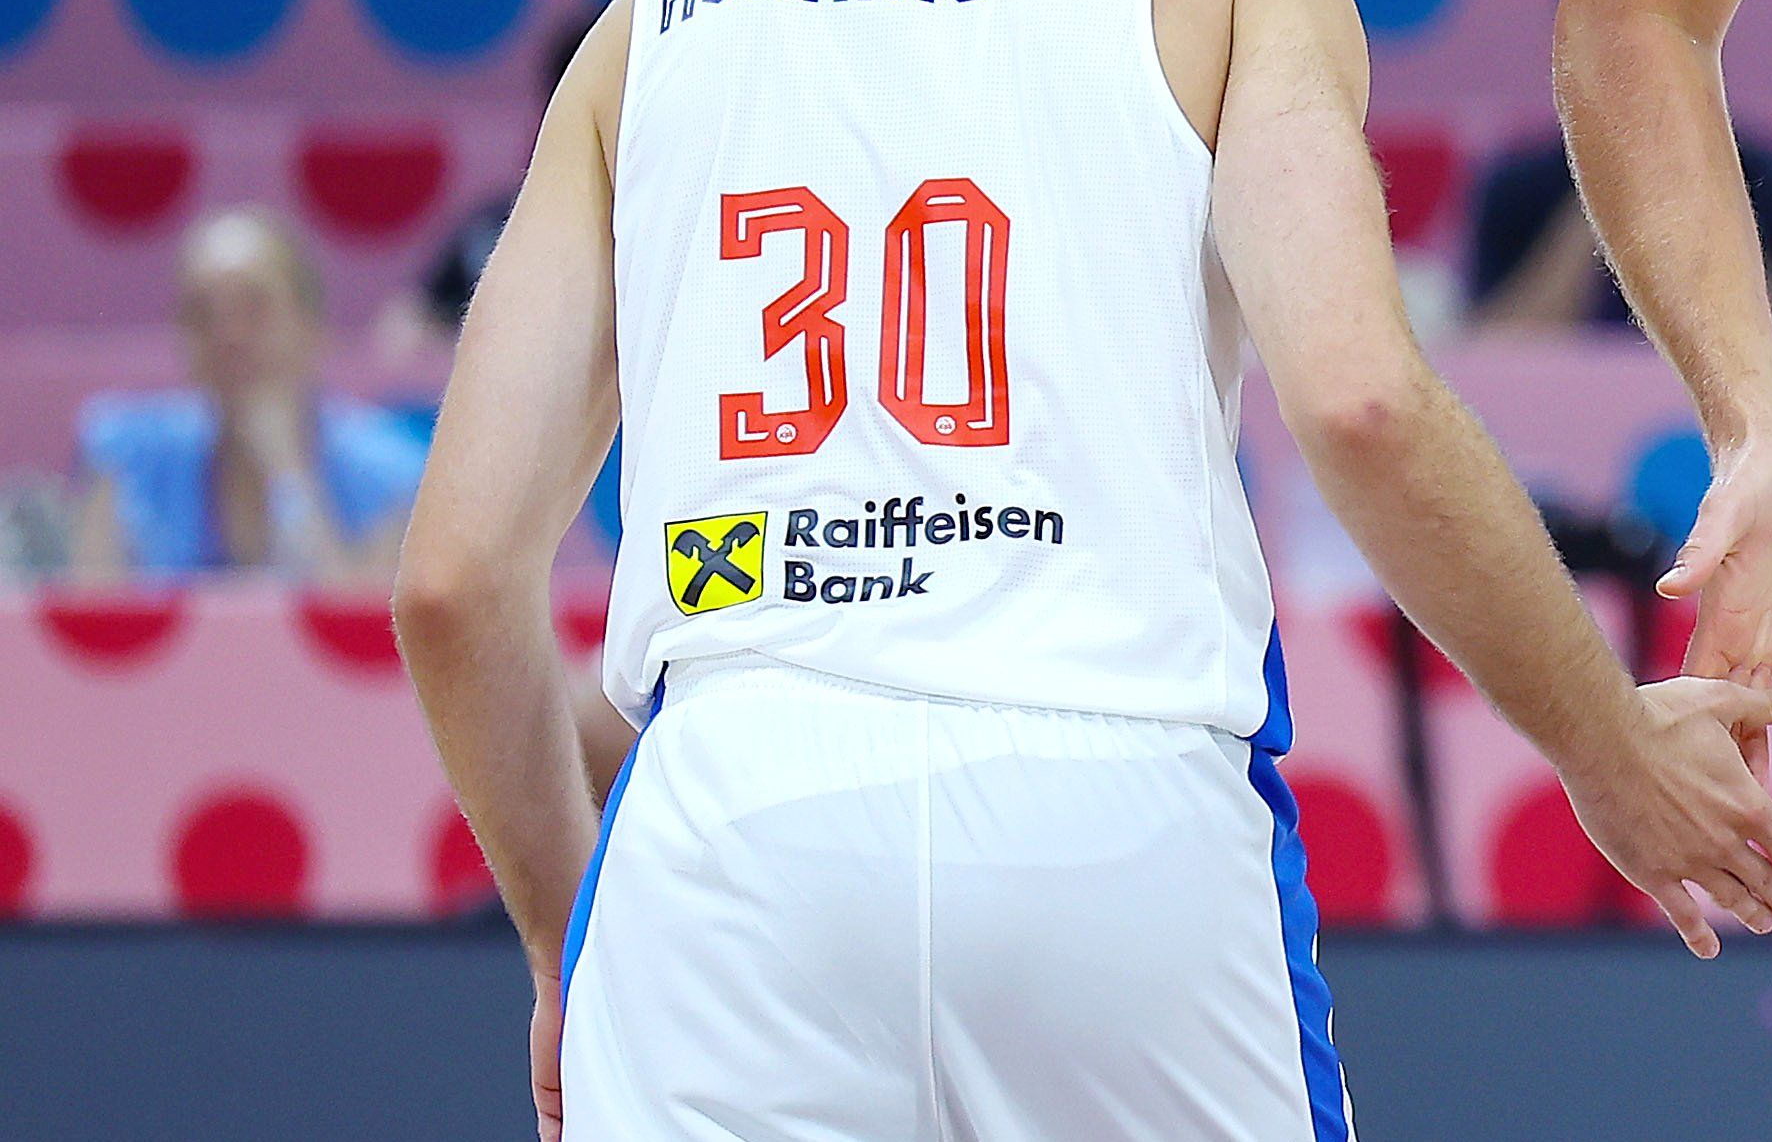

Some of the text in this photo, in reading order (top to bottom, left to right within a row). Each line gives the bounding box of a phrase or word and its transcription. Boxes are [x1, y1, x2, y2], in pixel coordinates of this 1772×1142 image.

[719, 178, 1010, 460] 30
[784, 493, 1063, 548] Raiffeisen
[783, 557, 934, 604] Bank
